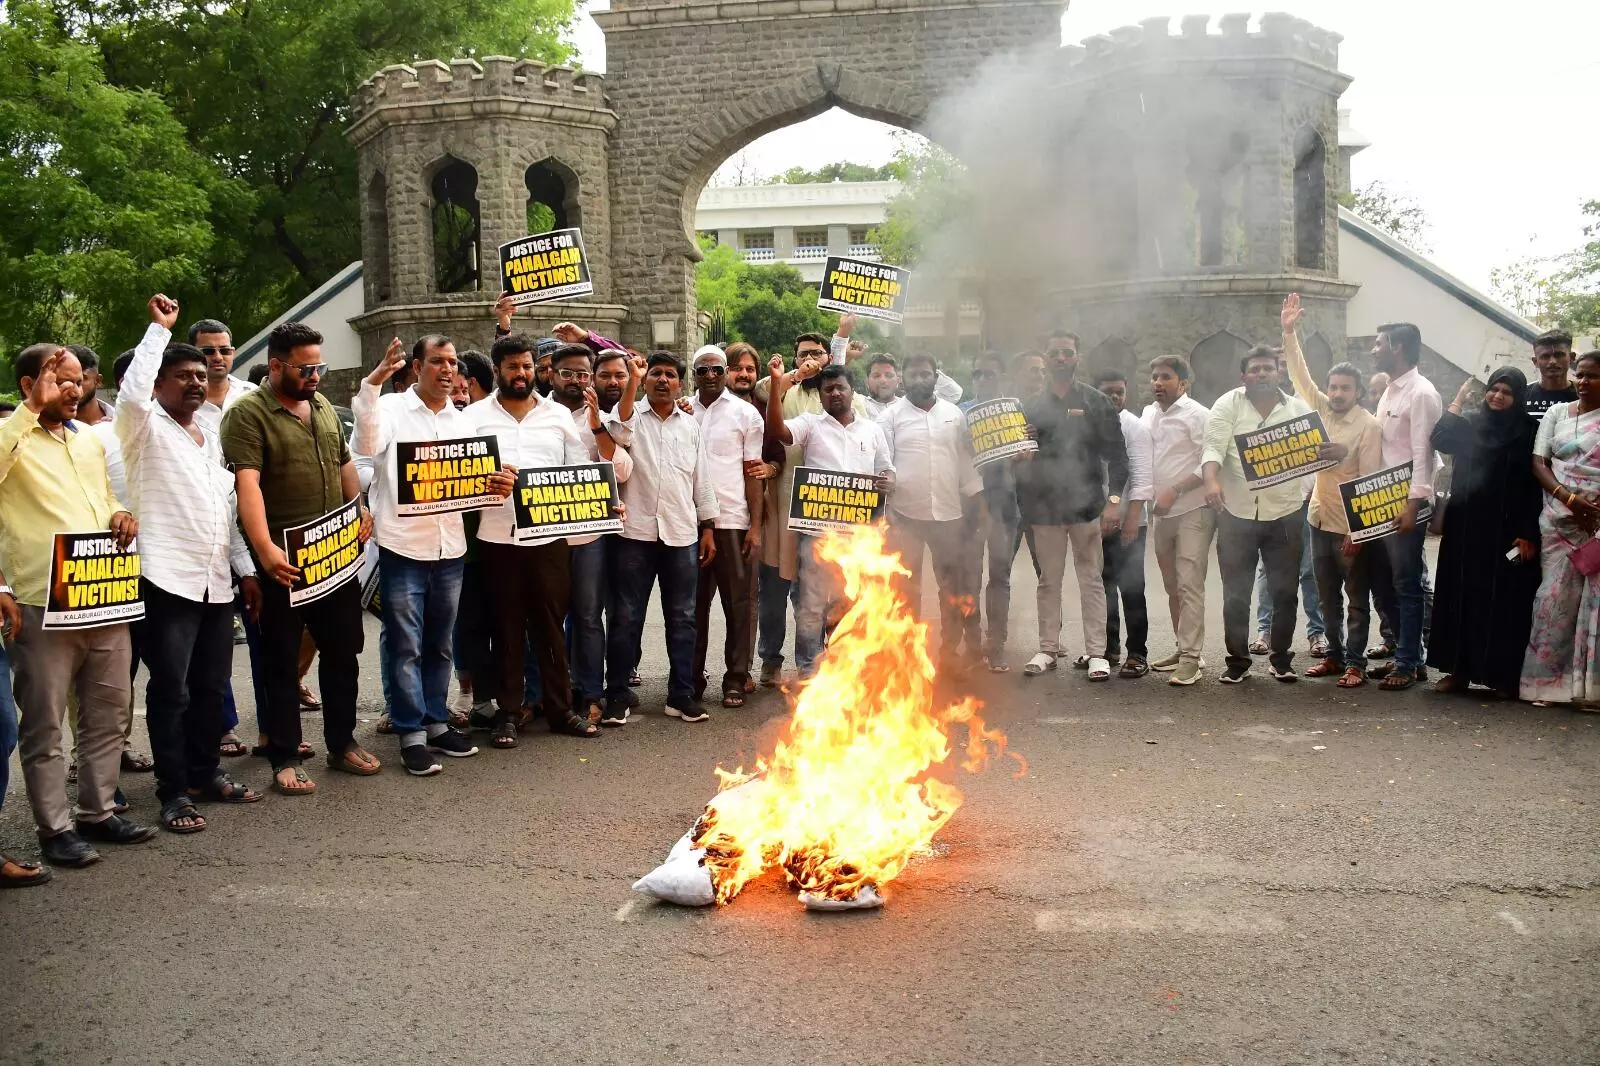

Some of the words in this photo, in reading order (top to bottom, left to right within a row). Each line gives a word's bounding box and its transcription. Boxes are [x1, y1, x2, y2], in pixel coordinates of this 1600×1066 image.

[510, 238, 552, 258] JUSTICE
[553, 235, 573, 248] FOR
[506, 248, 581, 277] PAHALGAM
[838, 261, 877, 277] JUSTICE
[879, 268, 897, 280] FOR
[511, 265, 580, 293] VICTIMS!
[830, 271, 901, 296] PAHALGAM
[832, 285, 894, 309] VICTIMS!
[1001, 402, 1017, 412] FOR
[970, 412, 1026, 439] AHALGAM
[1246, 426, 1289, 448] JUSTICE
[1289, 419, 1311, 434] FOR
[414, 444, 464, 460] JUSTICE
[467, 442, 487, 456] FOR
[1244, 429, 1323, 463] PAHALGAM
[407, 456, 495, 481] PAHALGAM
[528, 471, 575, 485] JUSTICE
[577, 469, 601, 482] FOR
[807, 473, 850, 488] JUSTICE
[852, 478, 872, 490] FOR
[1355, 473, 1393, 495] JUSTICE
[1393, 467, 1411, 482] FOR
[412, 503, 448, 511] KALABURAGI
[470, 497, 500, 505] CONGRESS
[521, 482, 610, 505] PAHALGAM
[799, 485, 878, 507] PAHALGAM
[529, 501, 608, 523] VICTIMS!
[803, 502, 871, 524] VICTIMS!
[304, 515, 342, 545] JUSTICE
[343, 506, 357, 525] FOR
[72, 538, 118, 557] JUSTICE
[297, 517, 360, 568] PAHALGAM
[304, 539, 358, 584] VICTIMS!
[68, 579, 139, 608] VICTIMS!
[64, 611, 103, 620] KALABURAGI
